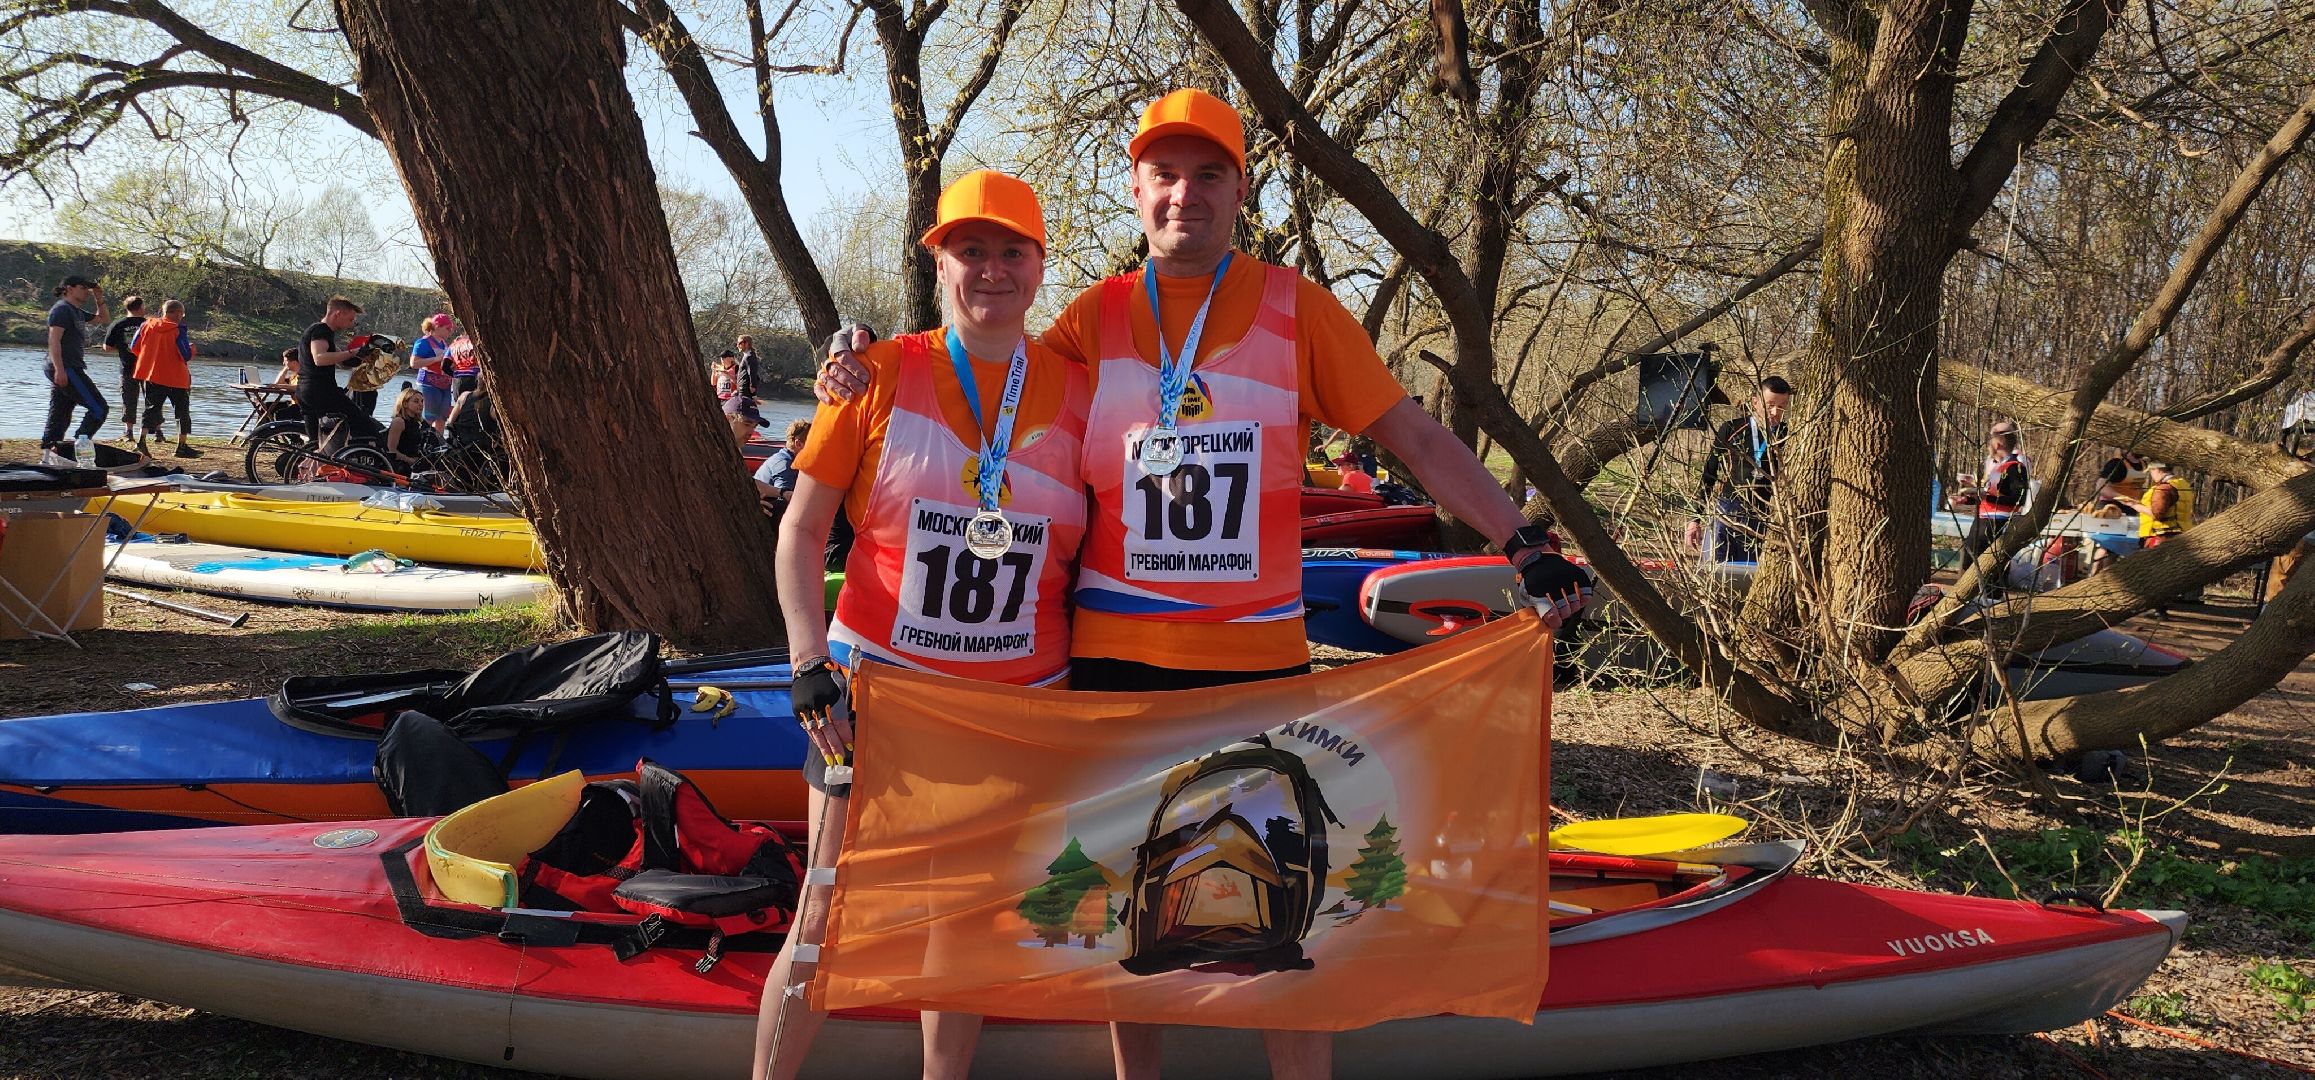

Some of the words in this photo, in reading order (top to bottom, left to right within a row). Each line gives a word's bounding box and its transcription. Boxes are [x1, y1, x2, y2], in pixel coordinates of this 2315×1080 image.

[1131, 427, 1254, 461] МОРЕЦКИЙ
[1135, 463, 1249, 541] 187
[917, 509, 1045, 546] МОСККИЙ
[1130, 550, 1187, 572] ГРЕБНОЙ
[1188, 552, 1252, 572] МАРАФОН
[917, 544, 1034, 624] 187
[900, 624, 961, 653] ГРЕБНОЙ
[963, 631, 1030, 653] МАРАФОН
[1279, 720, 1366, 767] ХИМКИ
[1886, 927, 1996, 957] VUOKSA
